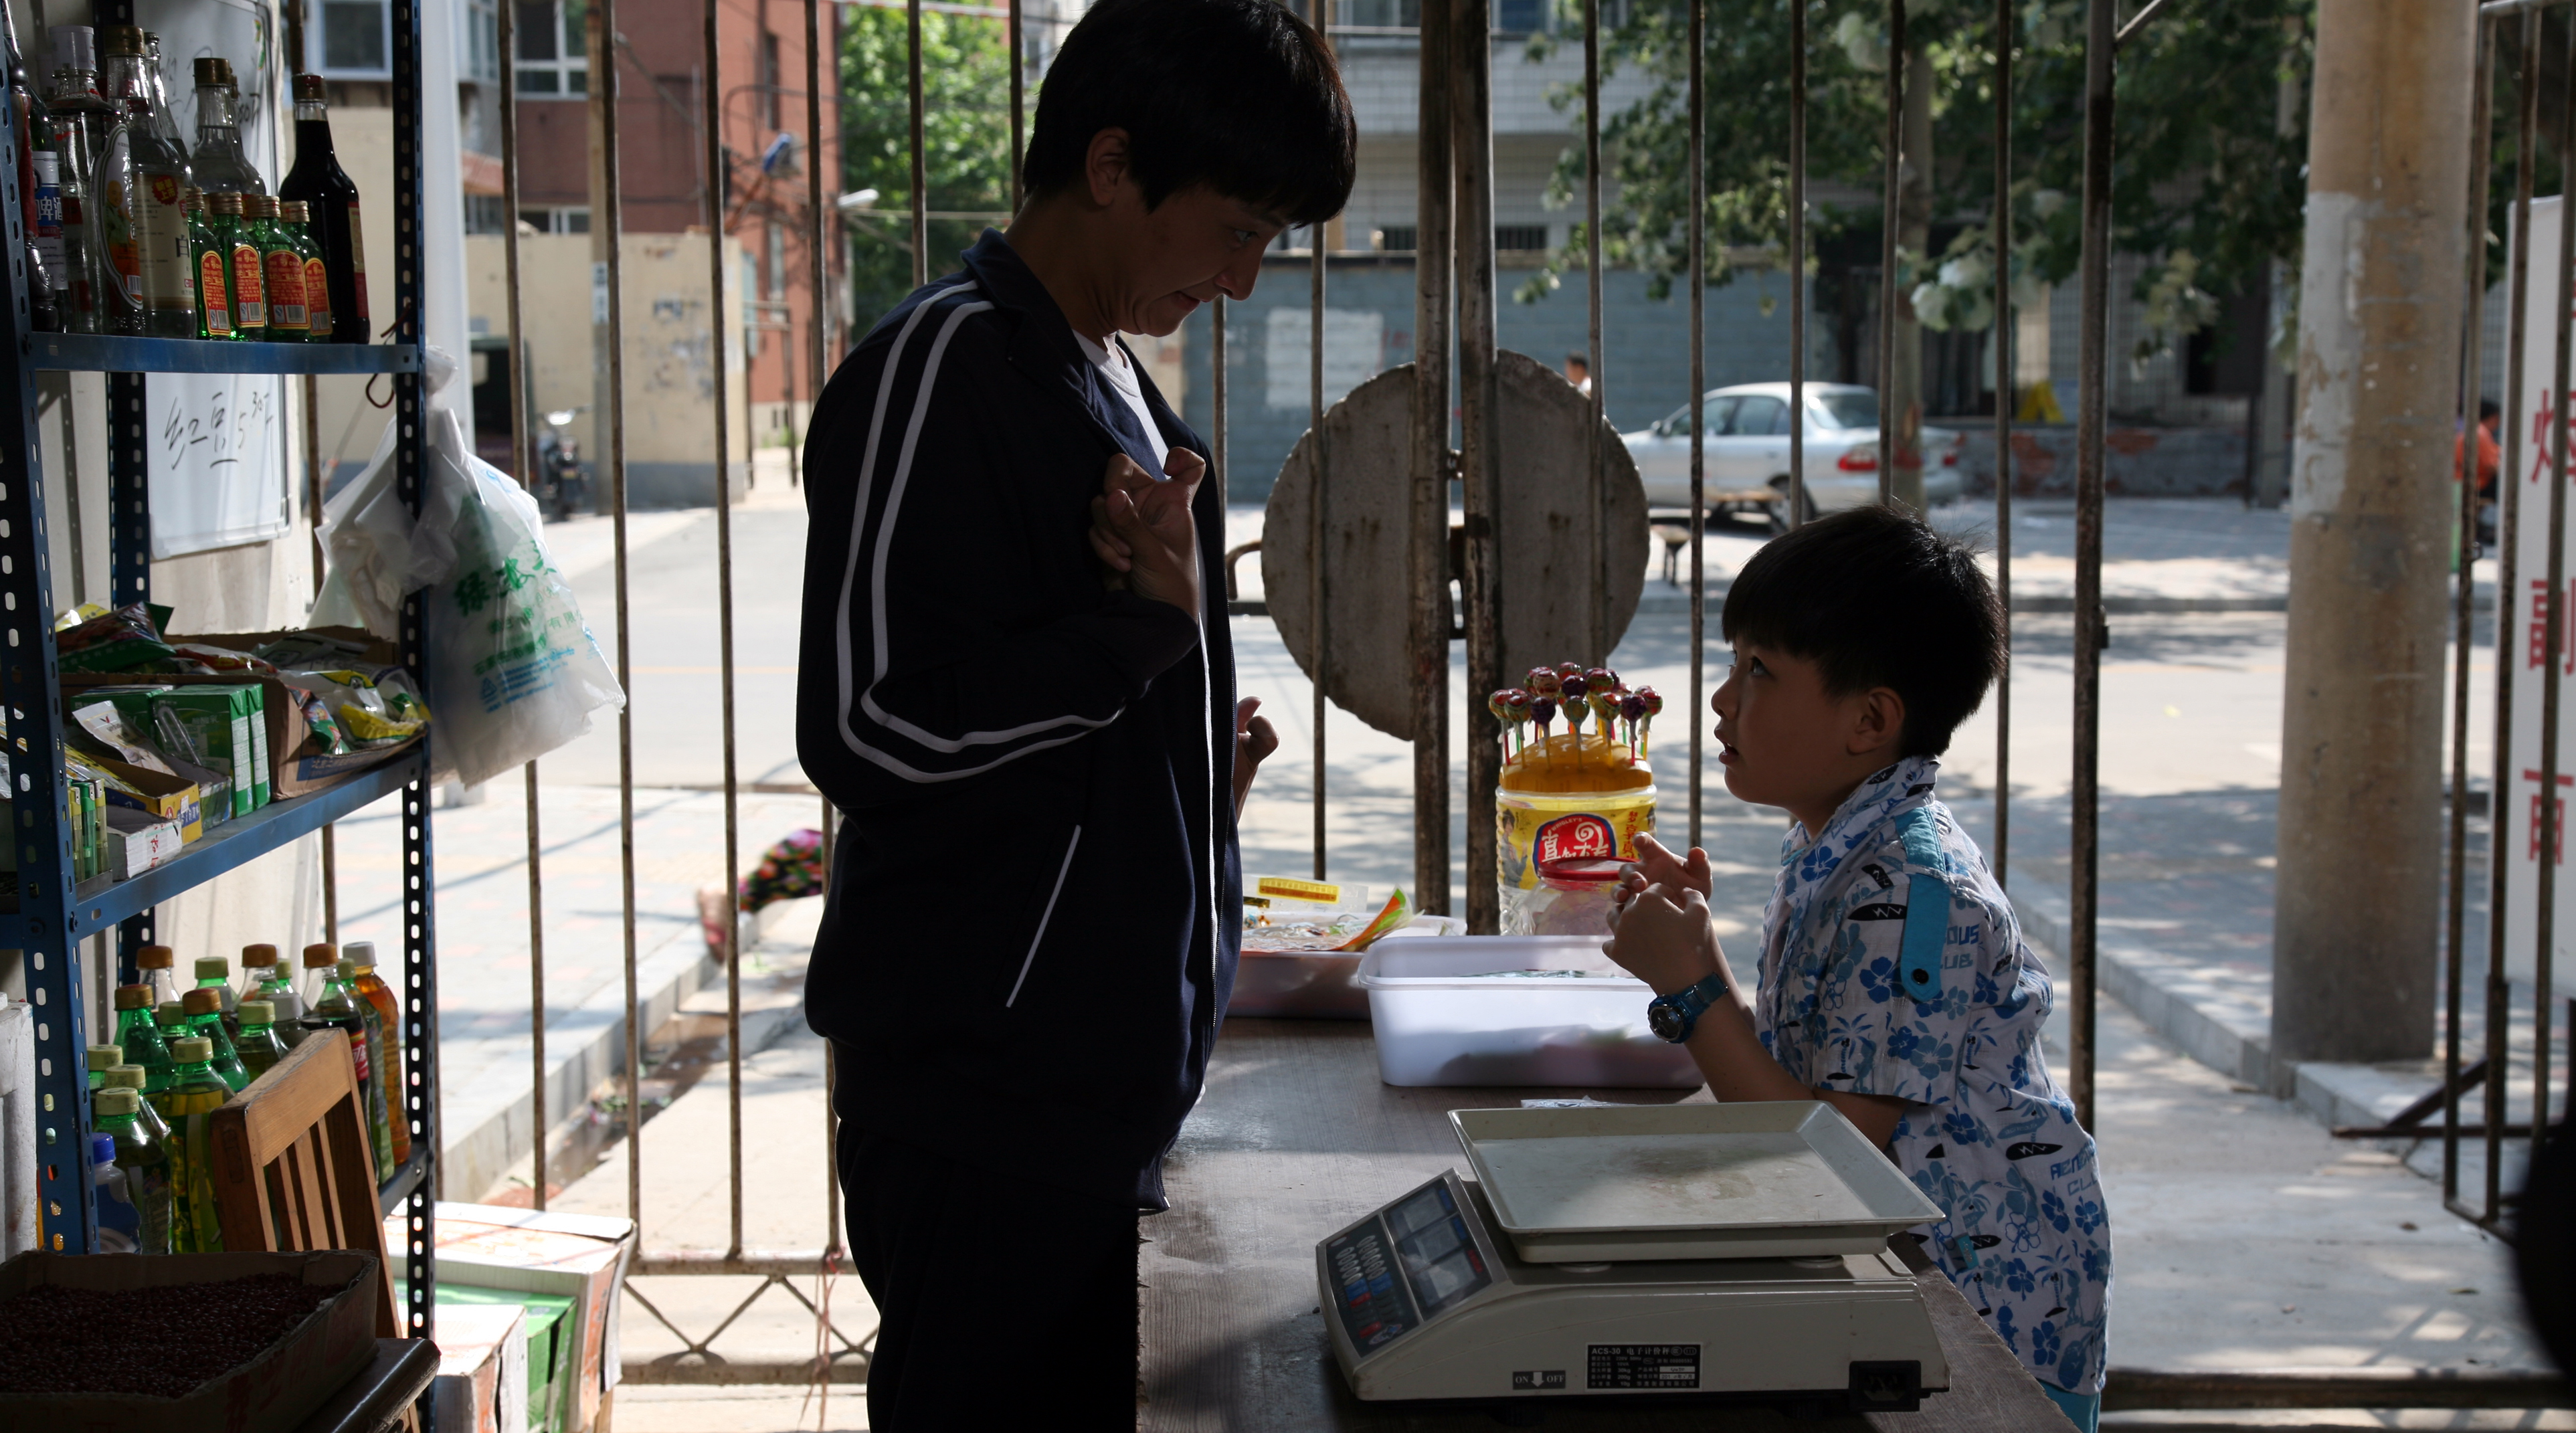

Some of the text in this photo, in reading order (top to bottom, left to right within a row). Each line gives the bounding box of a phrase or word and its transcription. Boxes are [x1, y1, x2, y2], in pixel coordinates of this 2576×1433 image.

[1551, 818, 1583, 832] WRIGLEY'S
[1591, 1347, 1621, 1355] ACS-30
[1515, 1374, 1565, 1384] ON OFF
